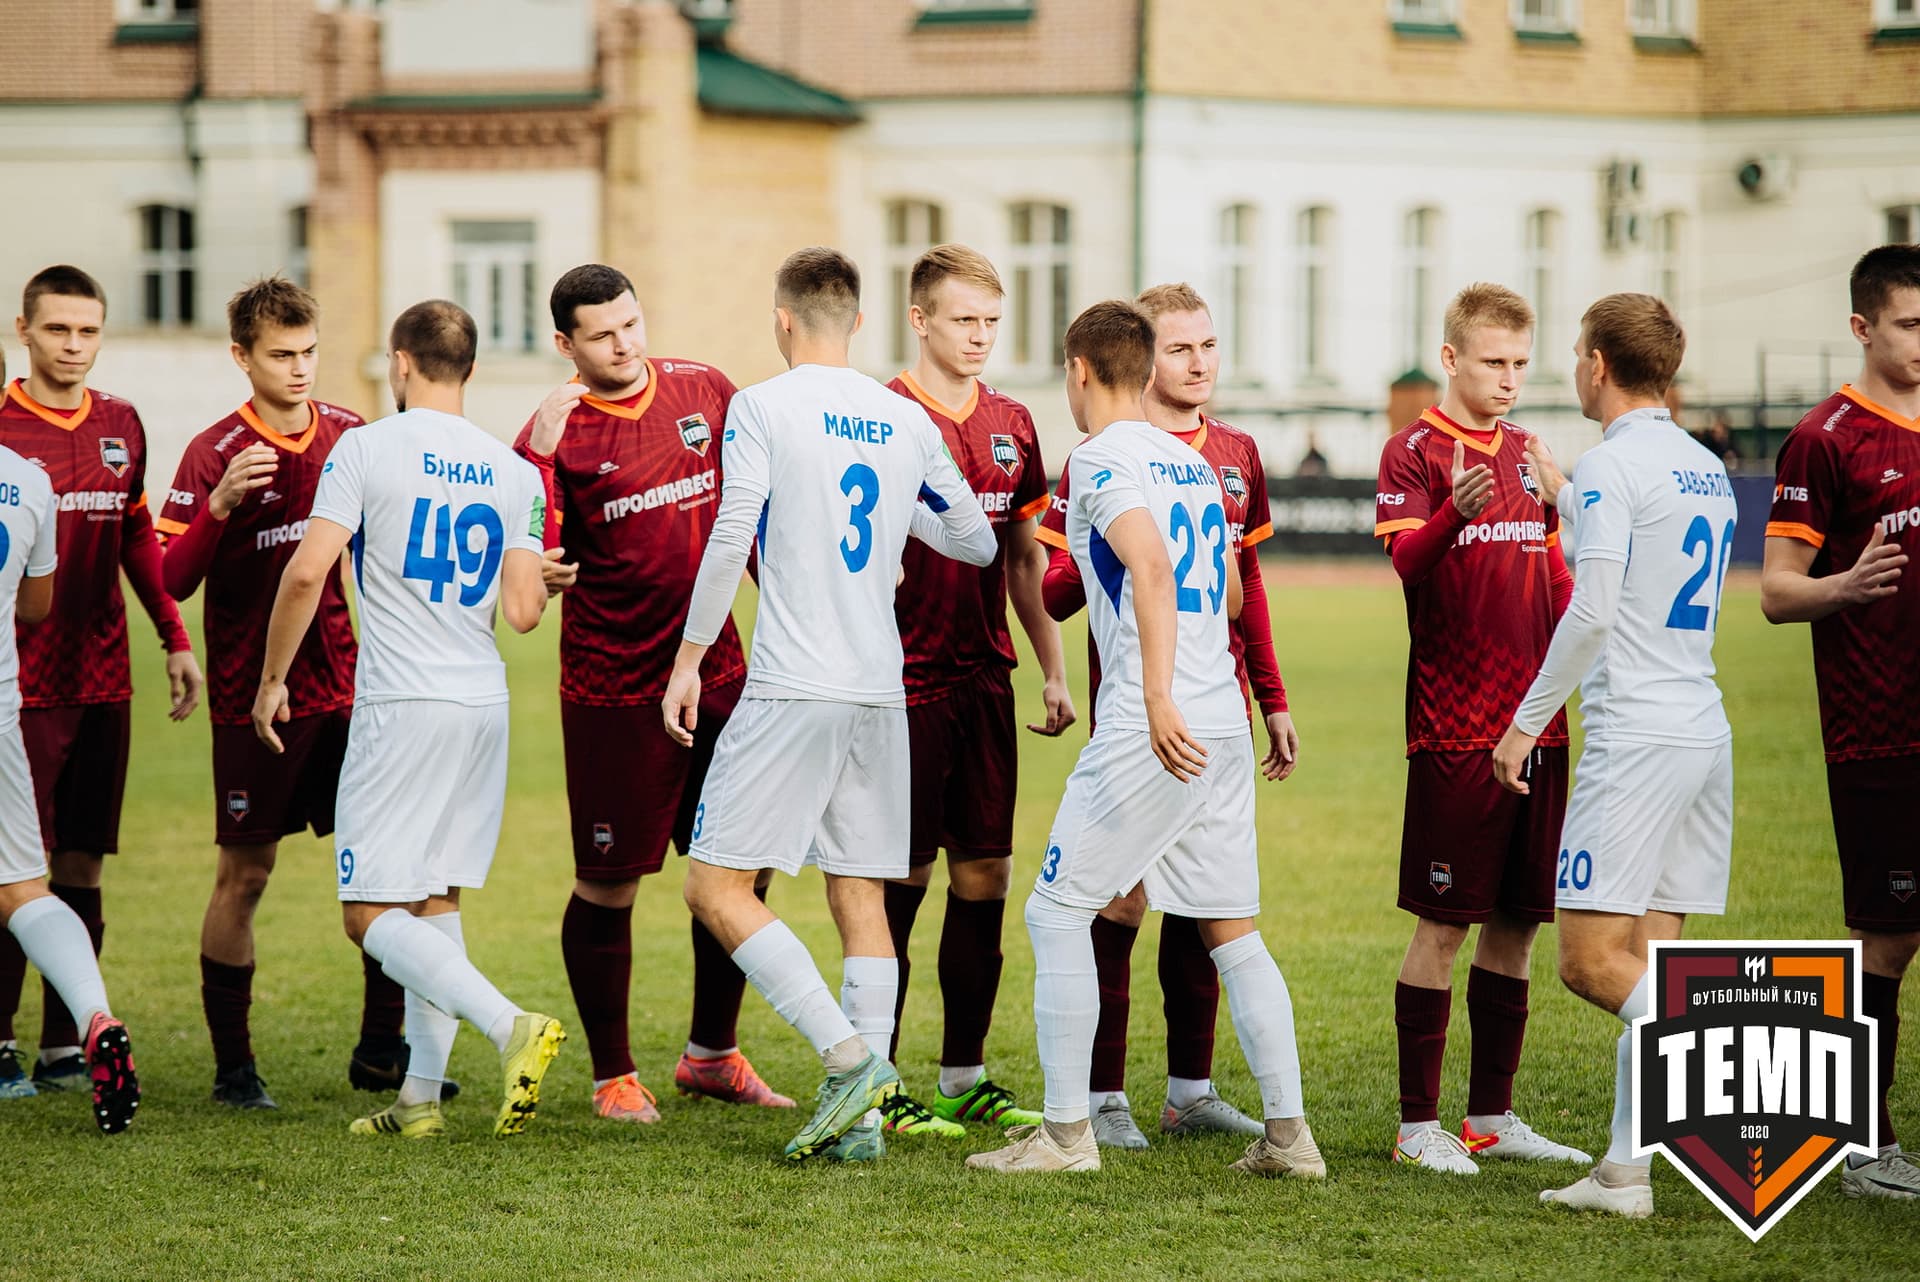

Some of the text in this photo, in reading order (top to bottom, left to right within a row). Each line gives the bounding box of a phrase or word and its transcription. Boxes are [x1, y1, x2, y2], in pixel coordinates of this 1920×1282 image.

[824, 411, 893, 444] МАЙЕР
[1783, 486, 1808, 501] ПСБ
[840, 463, 879, 573] 3
[403, 497, 504, 607] 49
[1170, 502, 1226, 616] 23
[693, 802, 705, 840] 3
[341, 848, 354, 885] 9
[1558, 848, 1592, 890] 20
